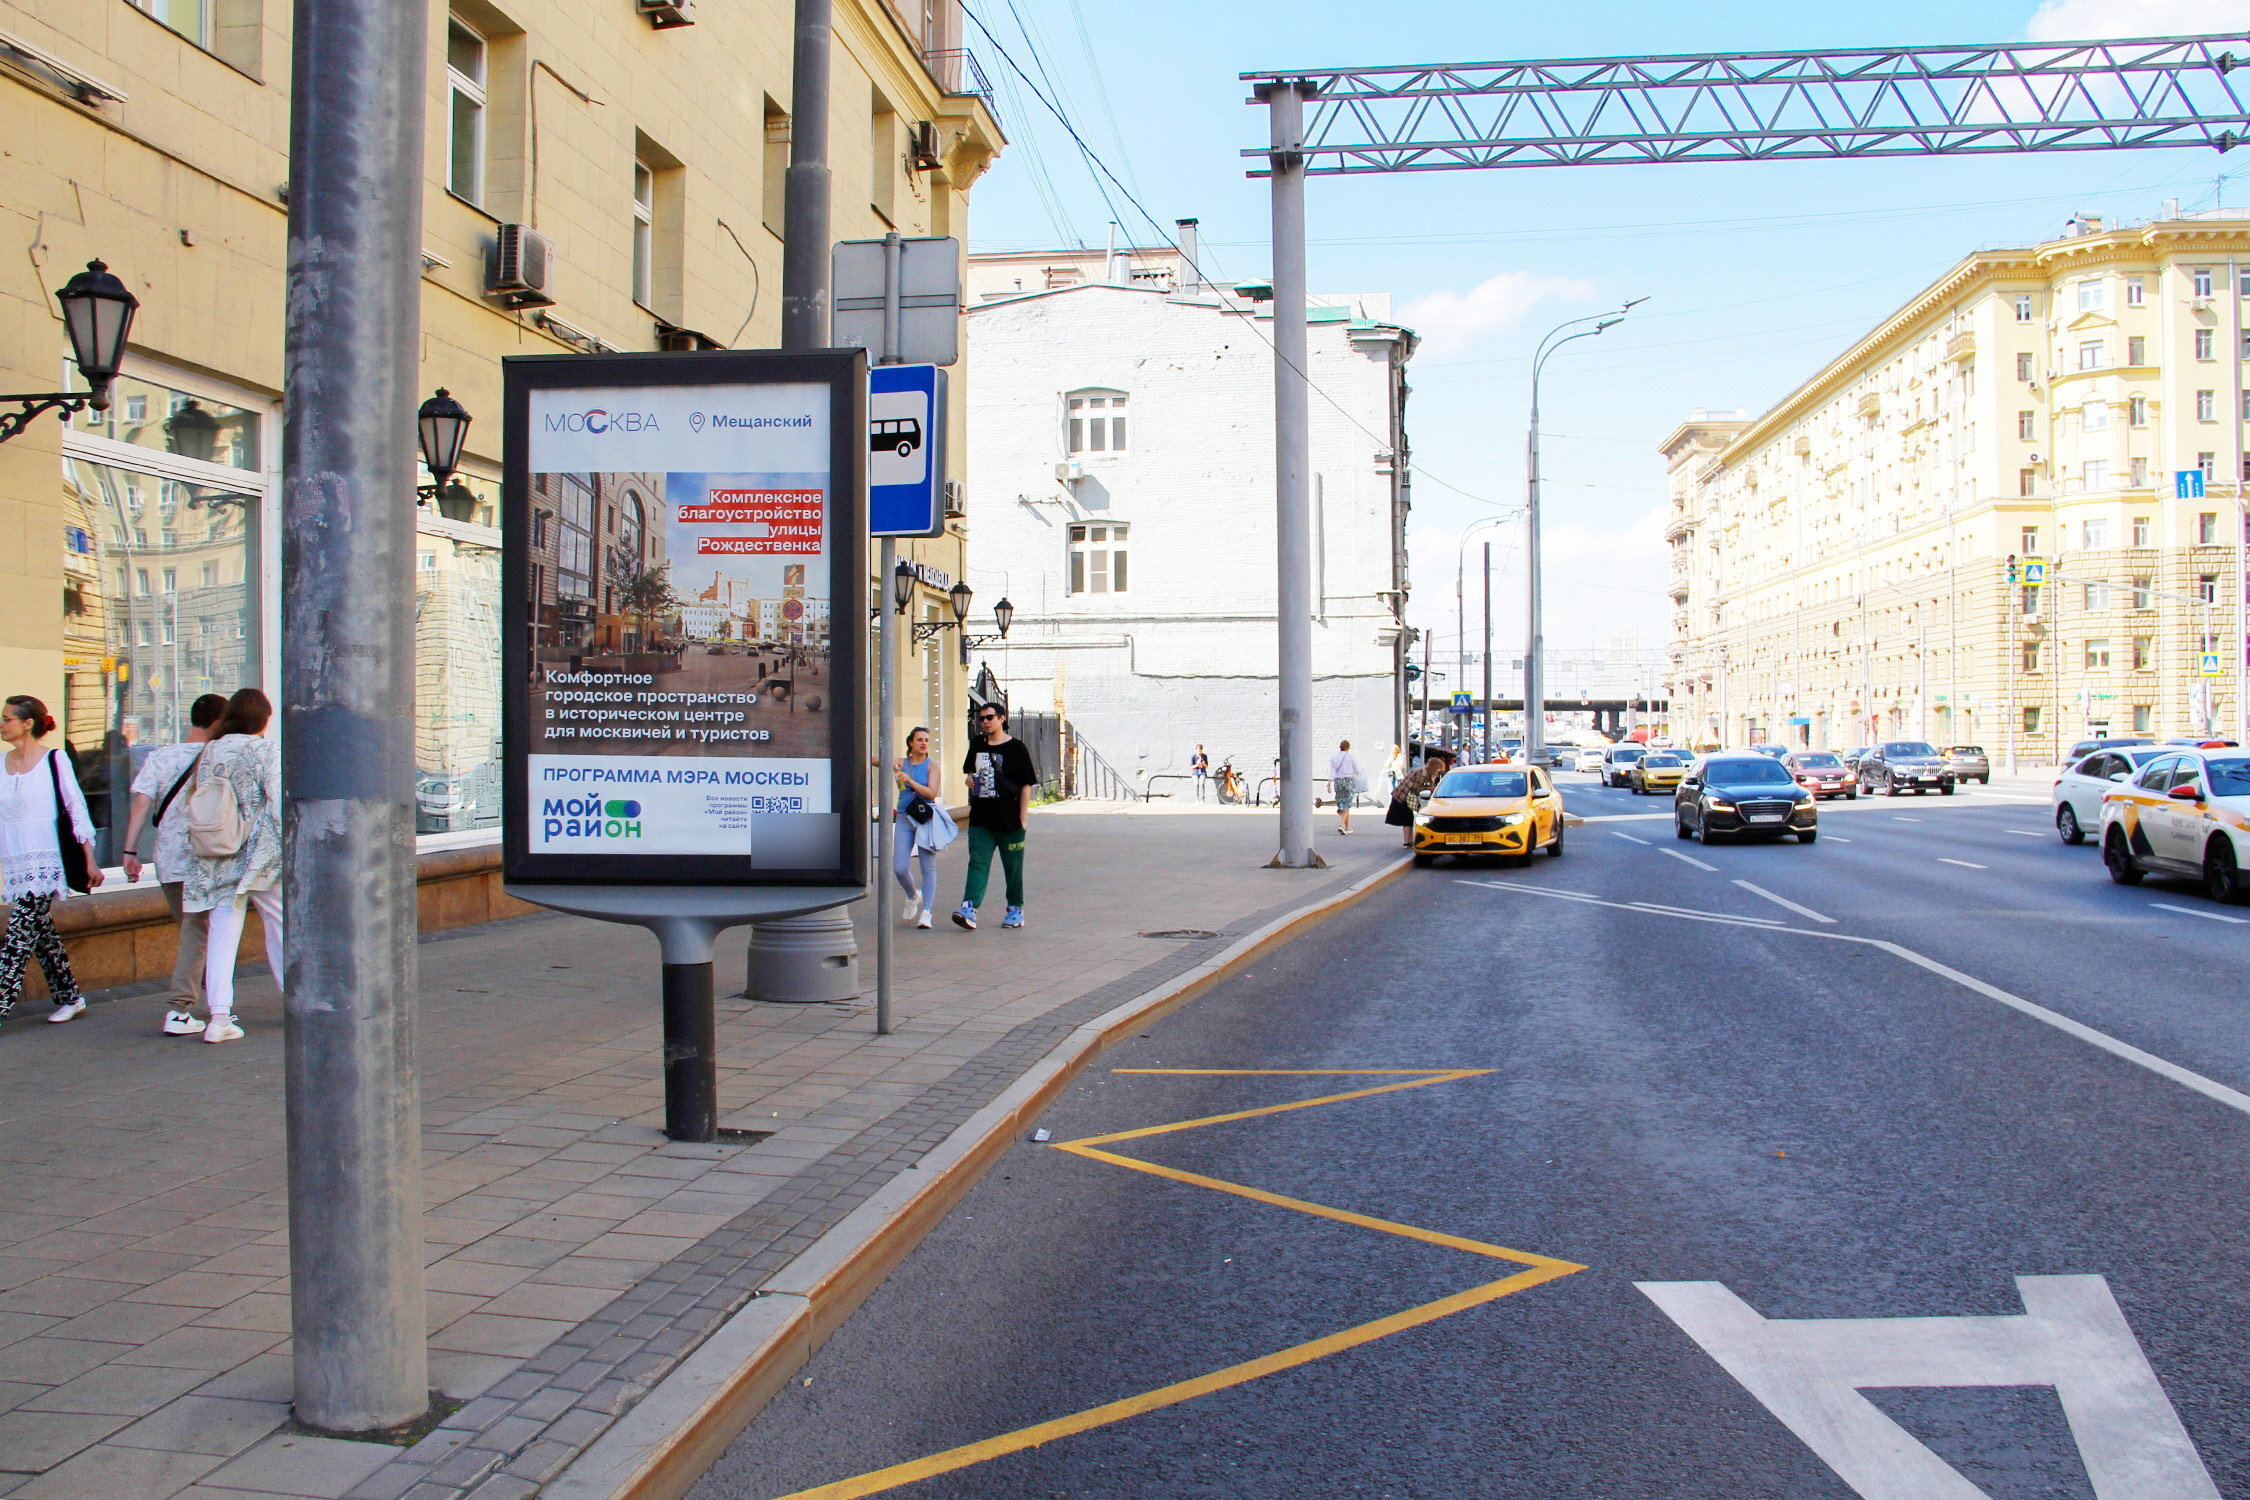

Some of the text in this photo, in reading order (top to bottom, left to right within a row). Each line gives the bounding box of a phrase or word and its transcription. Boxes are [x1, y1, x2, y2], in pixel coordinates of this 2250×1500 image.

[545, 409, 660, 434] МОСКВА
[712, 414, 813, 430] Мещанский
[710, 490, 822, 504] Комплексное
[678, 506, 822, 522] благоустройство
[769, 524, 821, 538] улицы
[698, 538, 821, 553] Рождественка
[545, 670, 653, 686] Комфортное
[545, 690, 757, 705] городское пространство
[545, 709, 745, 723] в историческом центре
[545, 725, 770, 742] для москвичей и туристов
[543, 768, 809, 786] ПРОГРАММА МЭРА МОСКВЫ
[543, 792, 602, 817] мой
